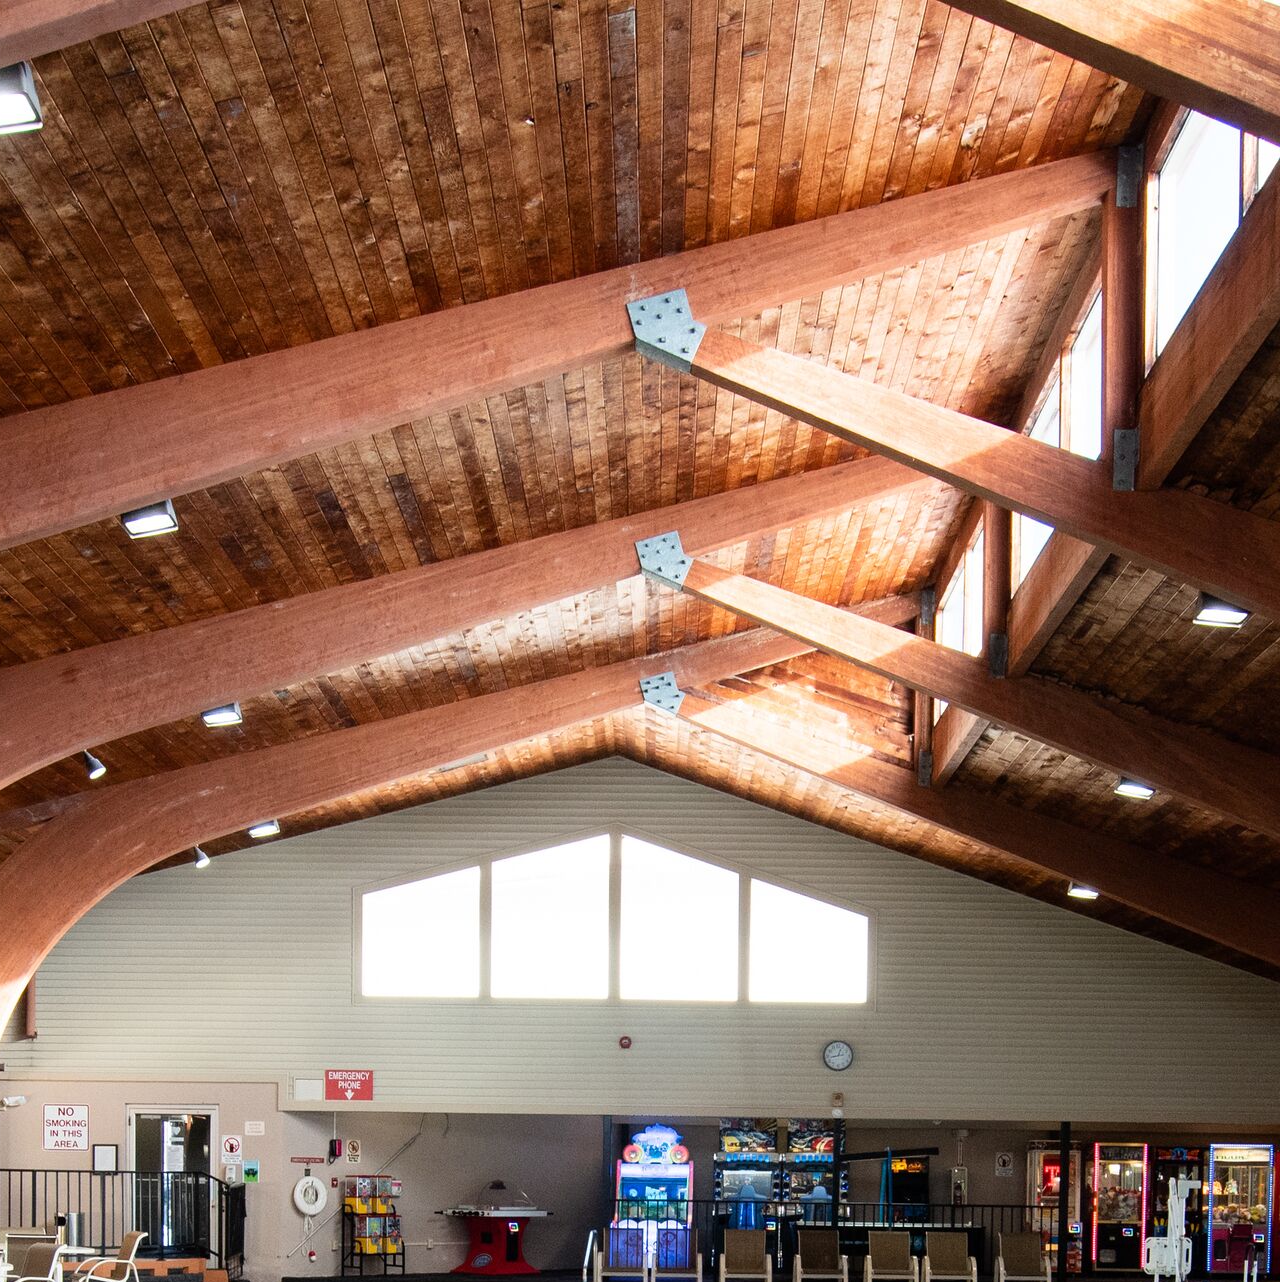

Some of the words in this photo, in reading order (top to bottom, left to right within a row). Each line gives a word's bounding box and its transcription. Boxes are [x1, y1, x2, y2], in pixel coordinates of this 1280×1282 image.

[328, 1071, 370, 1080] EMERGENCY
[338, 1080, 361, 1089] PHONE
[58, 1107, 74, 1116] NO
[46, 1119, 87, 1127] SMOKING
[50, 1129, 59, 1137] IN
[62, 1129, 82, 1137] THIS
[54, 1140, 78, 1148] AREA
